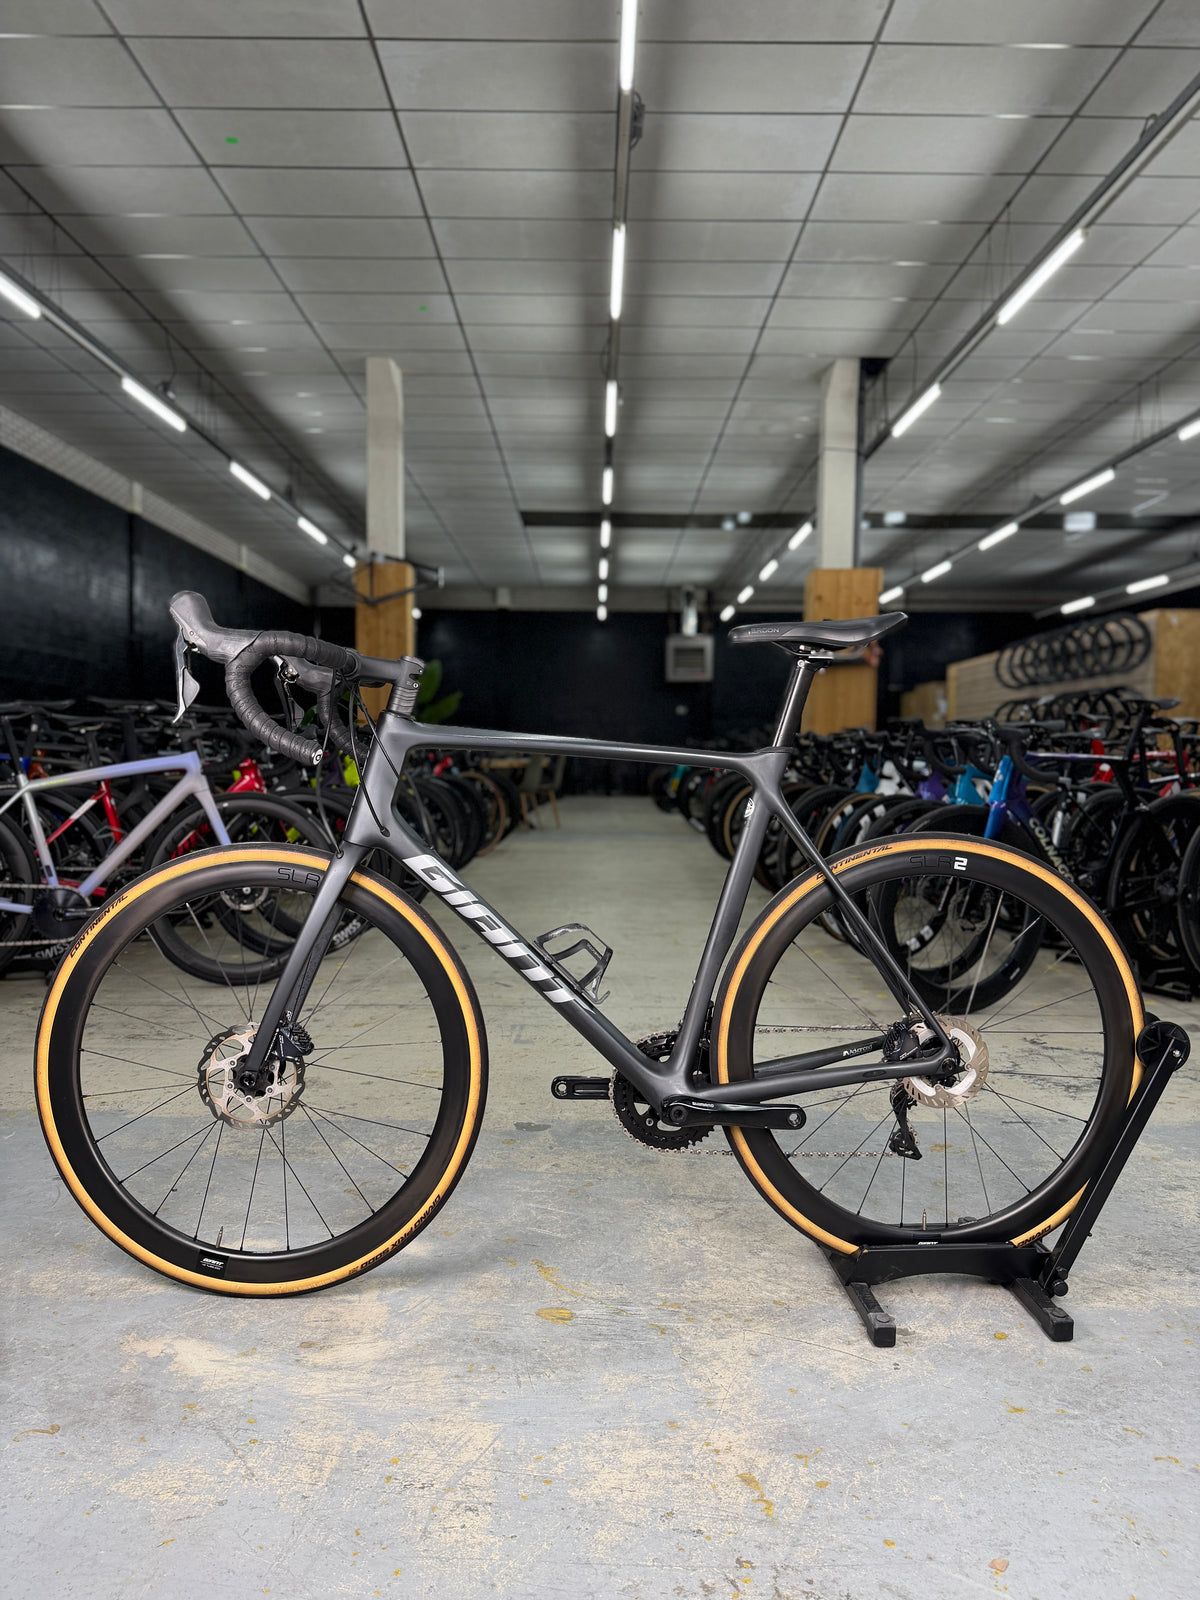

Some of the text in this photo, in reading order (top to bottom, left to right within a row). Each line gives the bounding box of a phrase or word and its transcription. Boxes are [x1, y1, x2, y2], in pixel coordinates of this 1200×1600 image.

[276, 866, 321, 887] SLR
[815, 844, 893, 880] CNTINENTAL
[69, 894, 129, 959] CONTINENTAL
[332, 919, 361, 946] SWISS
[401, 853, 597, 1015] GIANT
[414, 1194, 441, 1230] GRAND
[391, 1226, 414, 1250] PRIX
[360, 1247, 390, 1270] 5000
